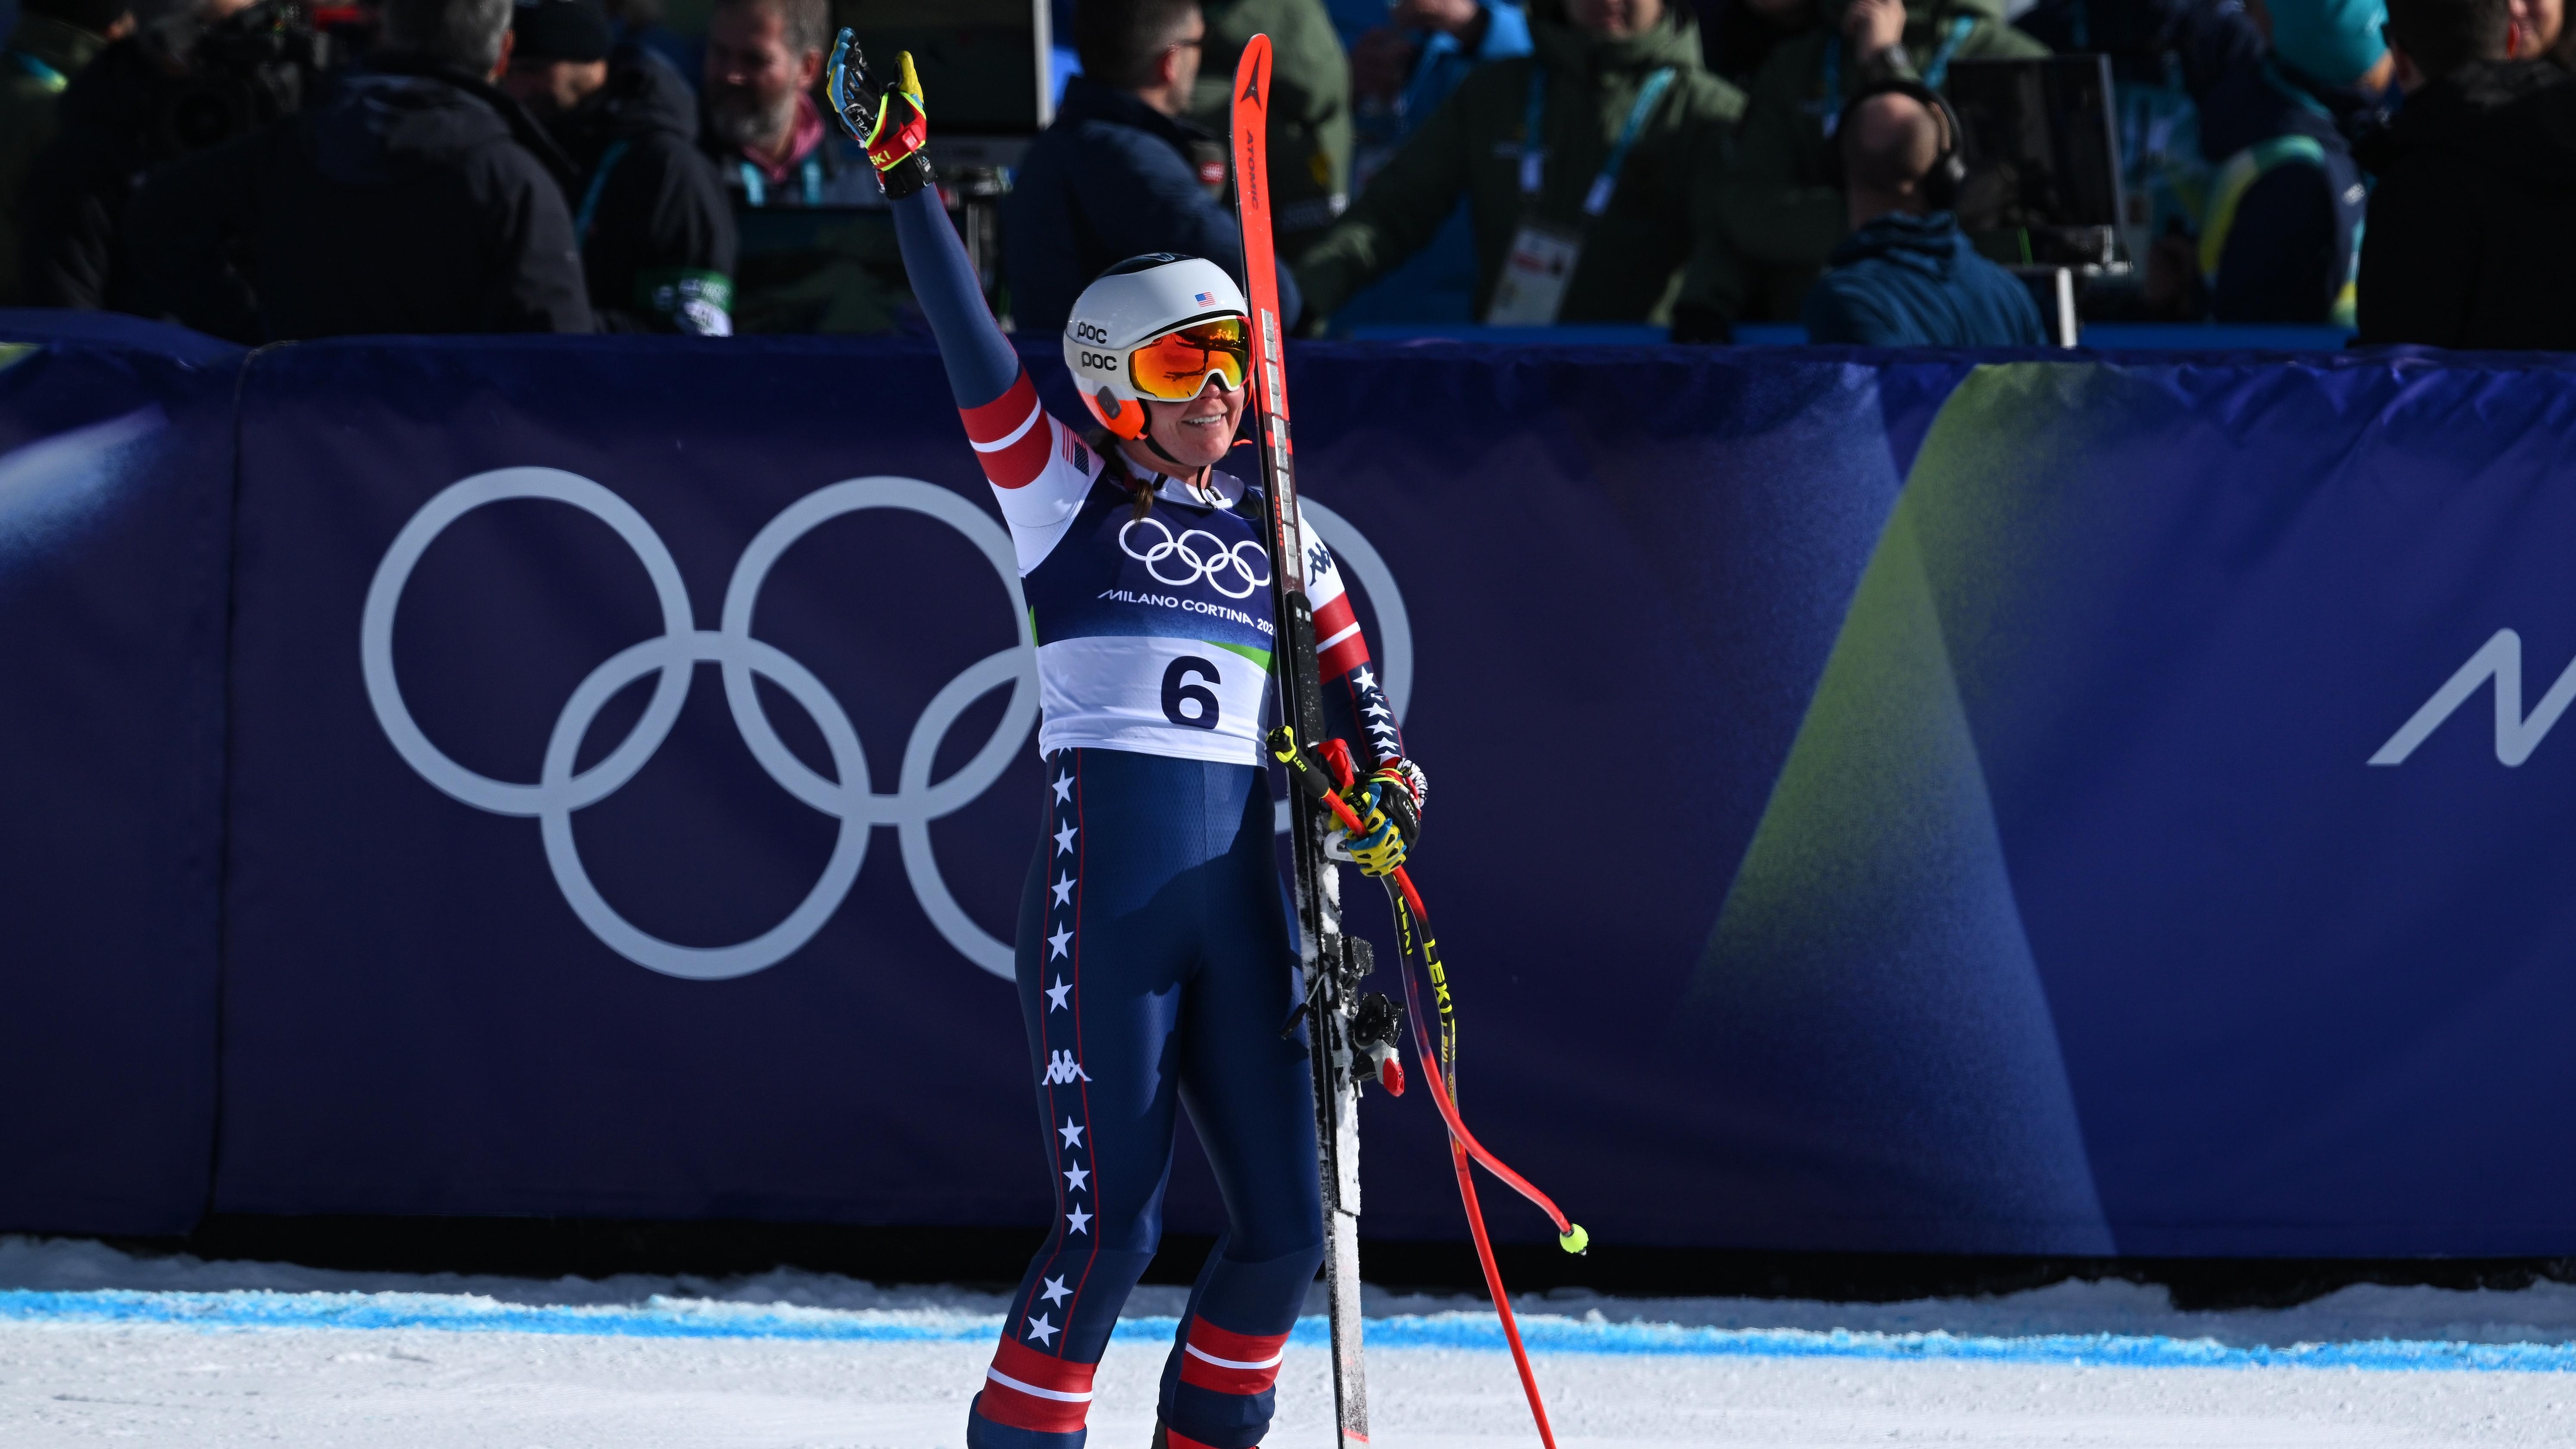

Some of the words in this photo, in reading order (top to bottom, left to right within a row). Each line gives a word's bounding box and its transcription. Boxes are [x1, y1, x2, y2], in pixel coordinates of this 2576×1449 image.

[854, 115, 872, 138] EVEL
[869, 150, 891, 166] EKI
[1247, 129, 1259, 211] ATOMIC
[1097, 589, 1178, 608] MILANO
[1182, 600, 1255, 627] CORTINA
[1161, 655, 1222, 730] 6
[1293, 756, 1307, 772] LEKI
[1424, 939, 1453, 1014] LEKI
